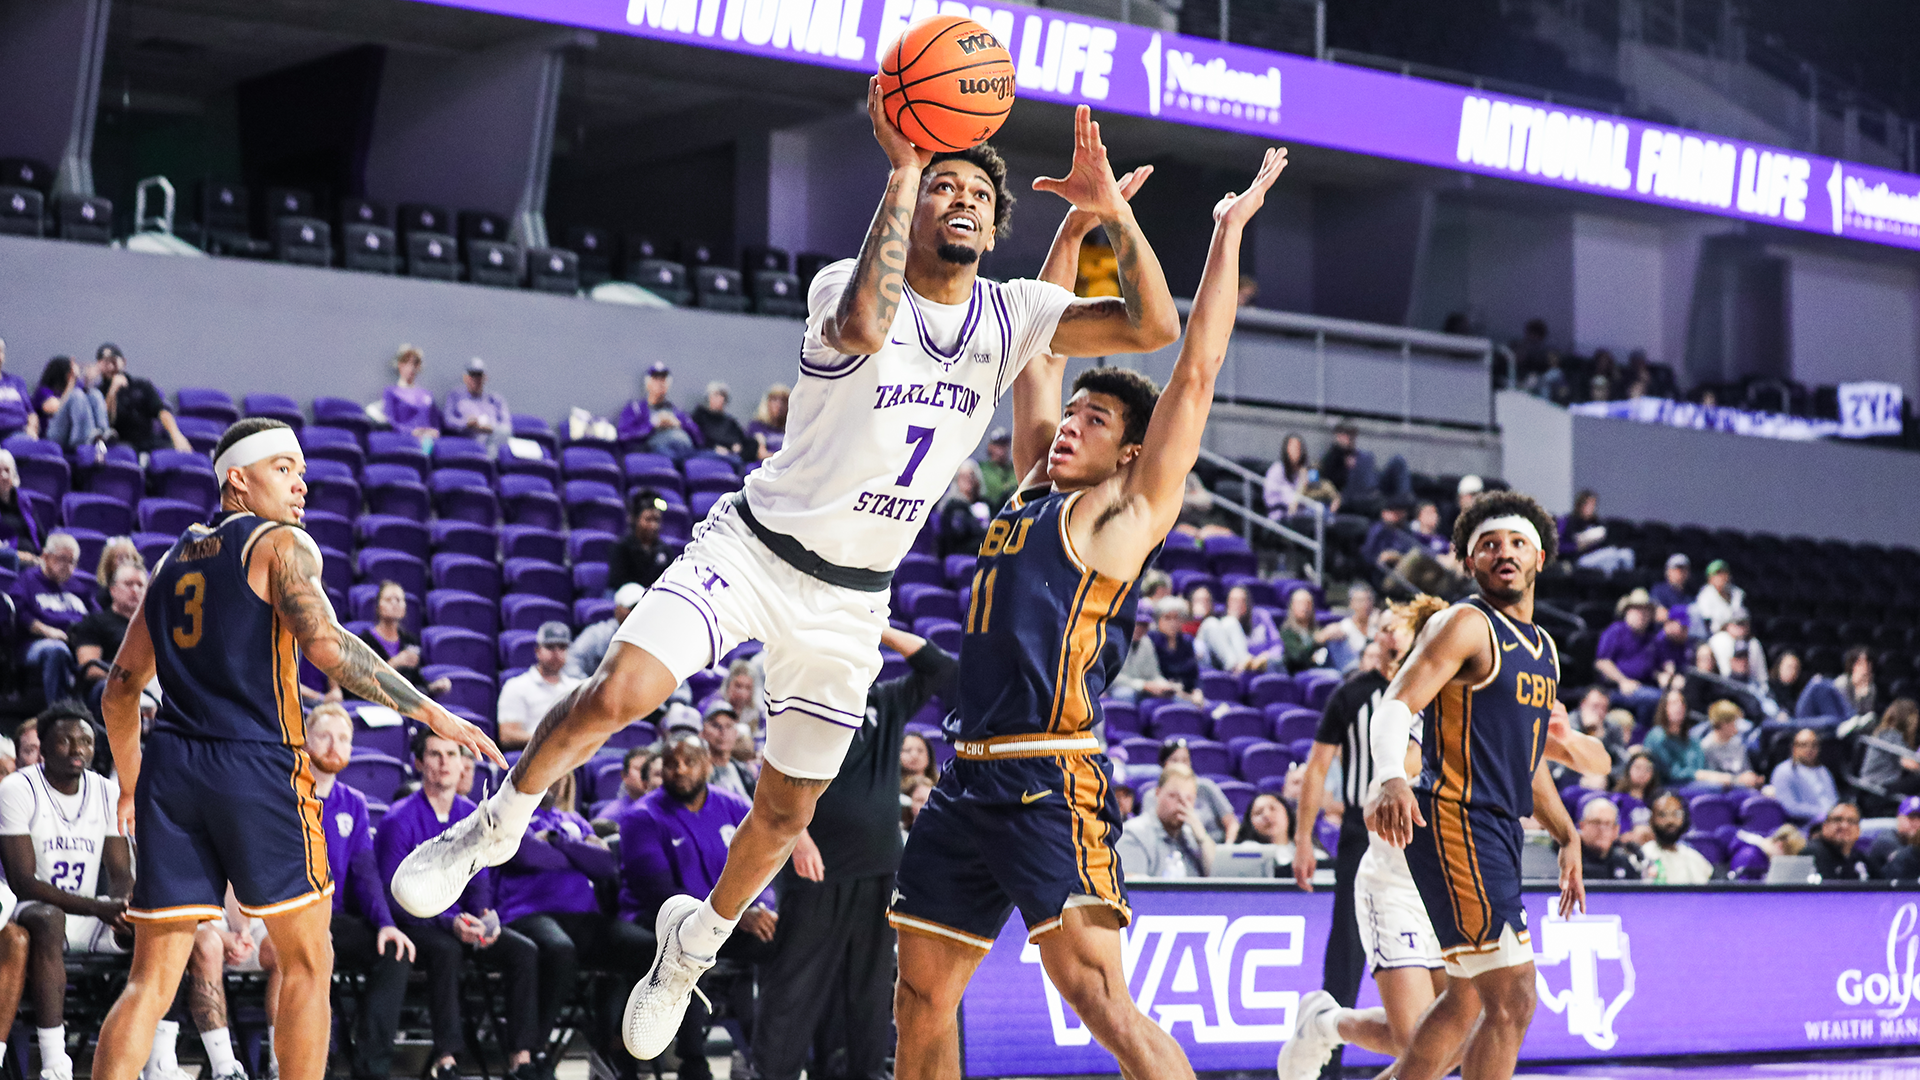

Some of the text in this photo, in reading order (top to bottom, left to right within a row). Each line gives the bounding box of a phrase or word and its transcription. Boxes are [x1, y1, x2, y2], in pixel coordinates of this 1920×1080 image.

[1016, 15, 1117, 100] LIFE
[1457, 95, 1811, 222] NATIONAL FARM LIFE
[873, 381, 981, 418] TARLETON
[895, 425, 936, 487] 7
[853, 491, 925, 522] STATE
[978, 518, 1034, 557] BU
[173, 571, 207, 649] 3
[966, 567, 997, 634] 11
[1516, 671, 1557, 710] CBU
[966, 742, 985, 755] CBU
[1530, 717, 1541, 772] 1
[51, 861, 86, 891] 23
[1400, 931, 1418, 949] T
[1804, 1019, 1874, 1041] WEALTH
